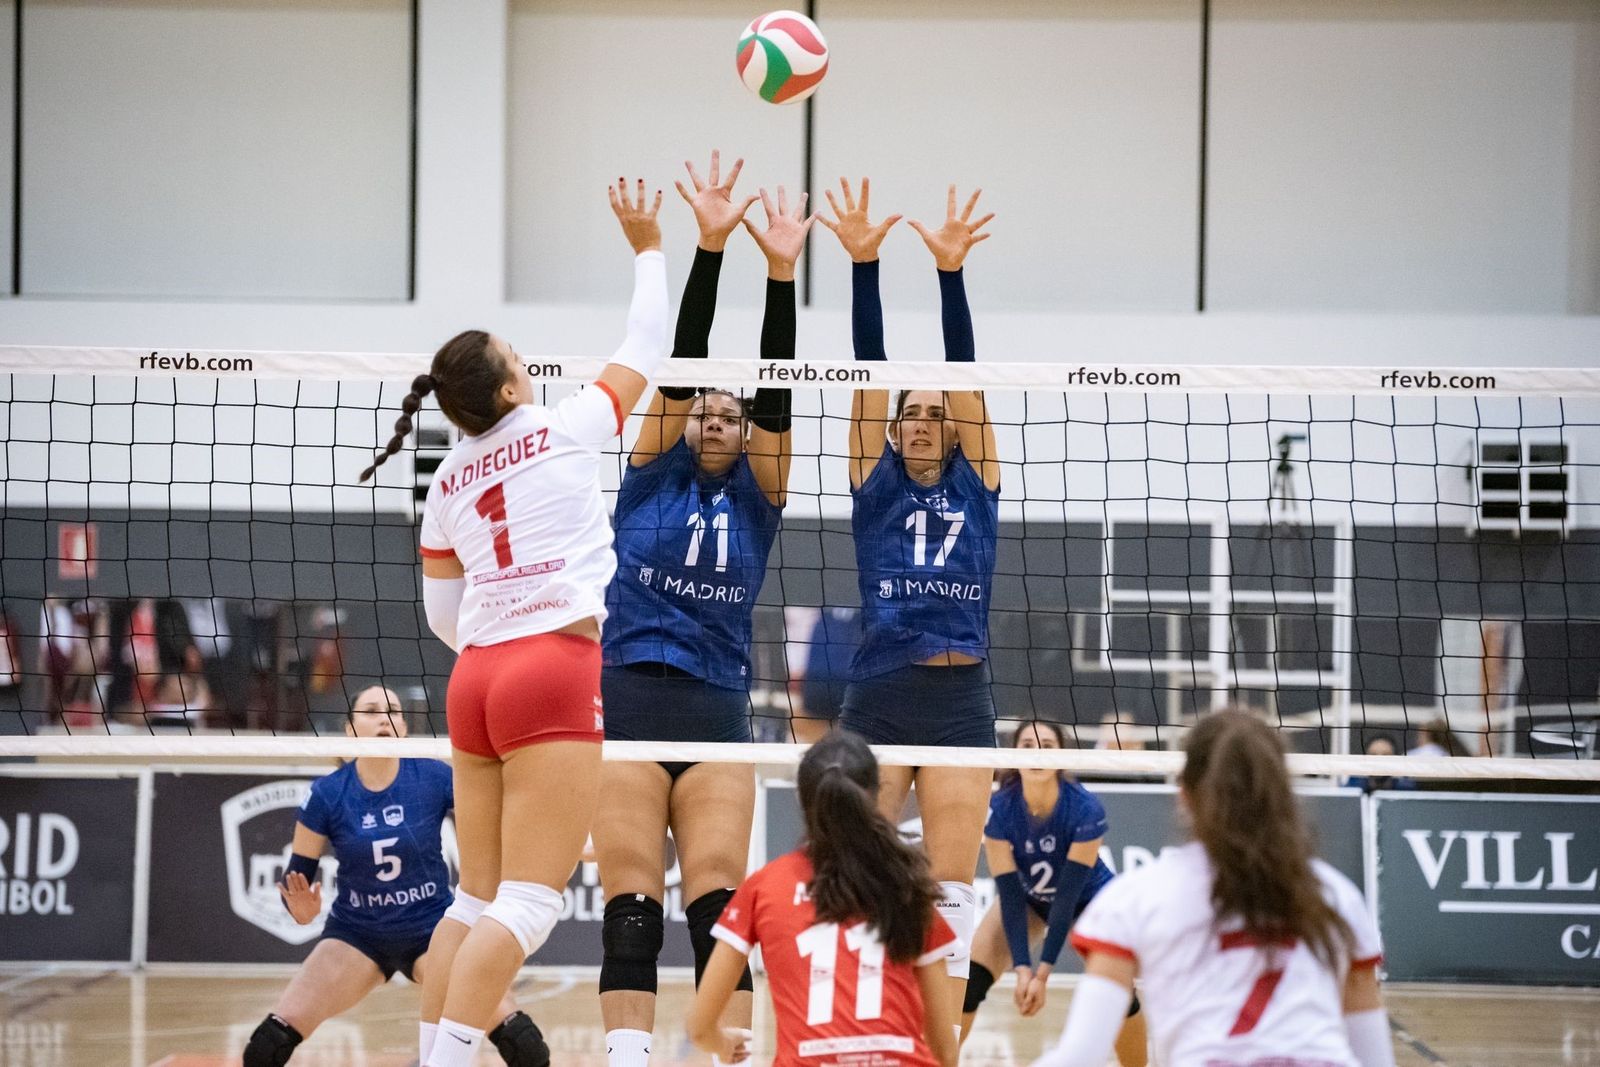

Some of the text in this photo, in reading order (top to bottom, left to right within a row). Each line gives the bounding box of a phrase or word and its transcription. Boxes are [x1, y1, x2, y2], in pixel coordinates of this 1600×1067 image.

[140, 352, 253, 371] rfevb.com
[758, 363, 870, 381] rfevb.com
[1068, 367, 1181, 385] rfevb.com
[1381, 370, 1496, 388] rfevb.com
[440, 427, 551, 498] M.DIEGUEZ
[474, 481, 513, 569] 1
[905, 510, 965, 567] 17
[684, 511, 729, 573] 11
[664, 575, 746, 602] MADRID
[905, 579, 981, 601] MADRID
[372, 837, 402, 882] 5
[368, 881, 437, 907] MADRID
[1030, 861, 1057, 894] 2
[795, 921, 885, 1027] 11
[1218, 930, 1298, 1039] 7
